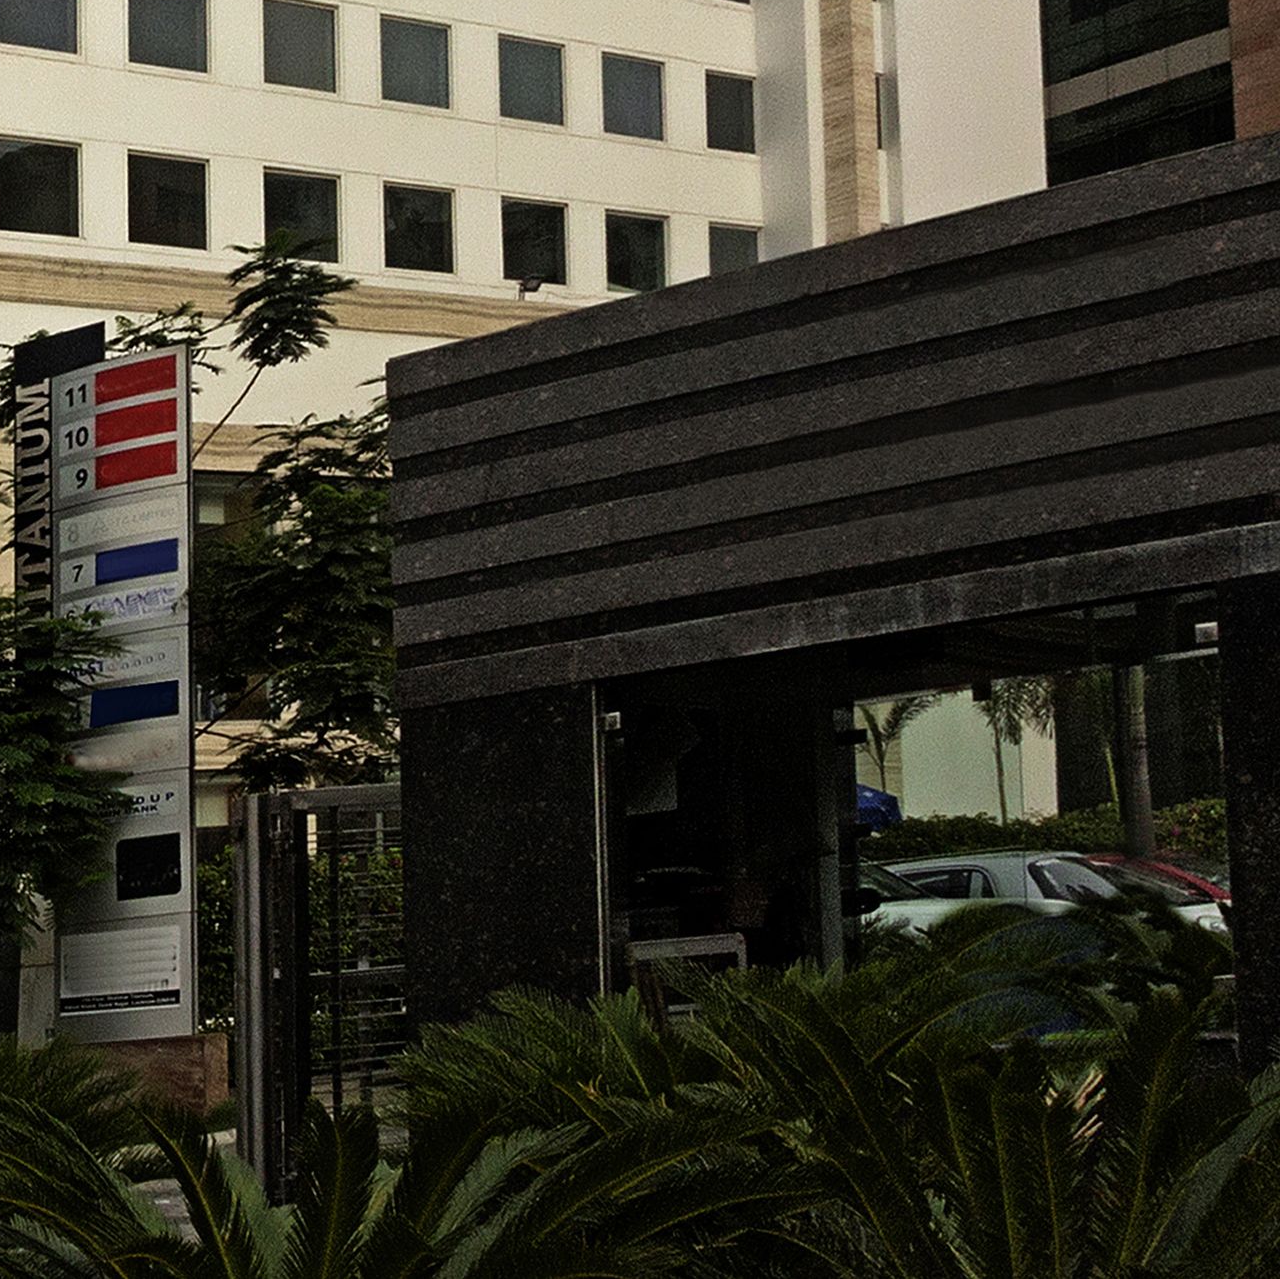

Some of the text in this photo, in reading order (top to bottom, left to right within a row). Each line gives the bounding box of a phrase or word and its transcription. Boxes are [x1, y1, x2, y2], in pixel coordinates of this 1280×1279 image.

[65, 383, 87, 408] 11
[64, 426, 89, 450] 10
[75, 468, 88, 489] 9
[15, 377, 51, 621] ITANIUM
[72, 564, 84, 583] 7
